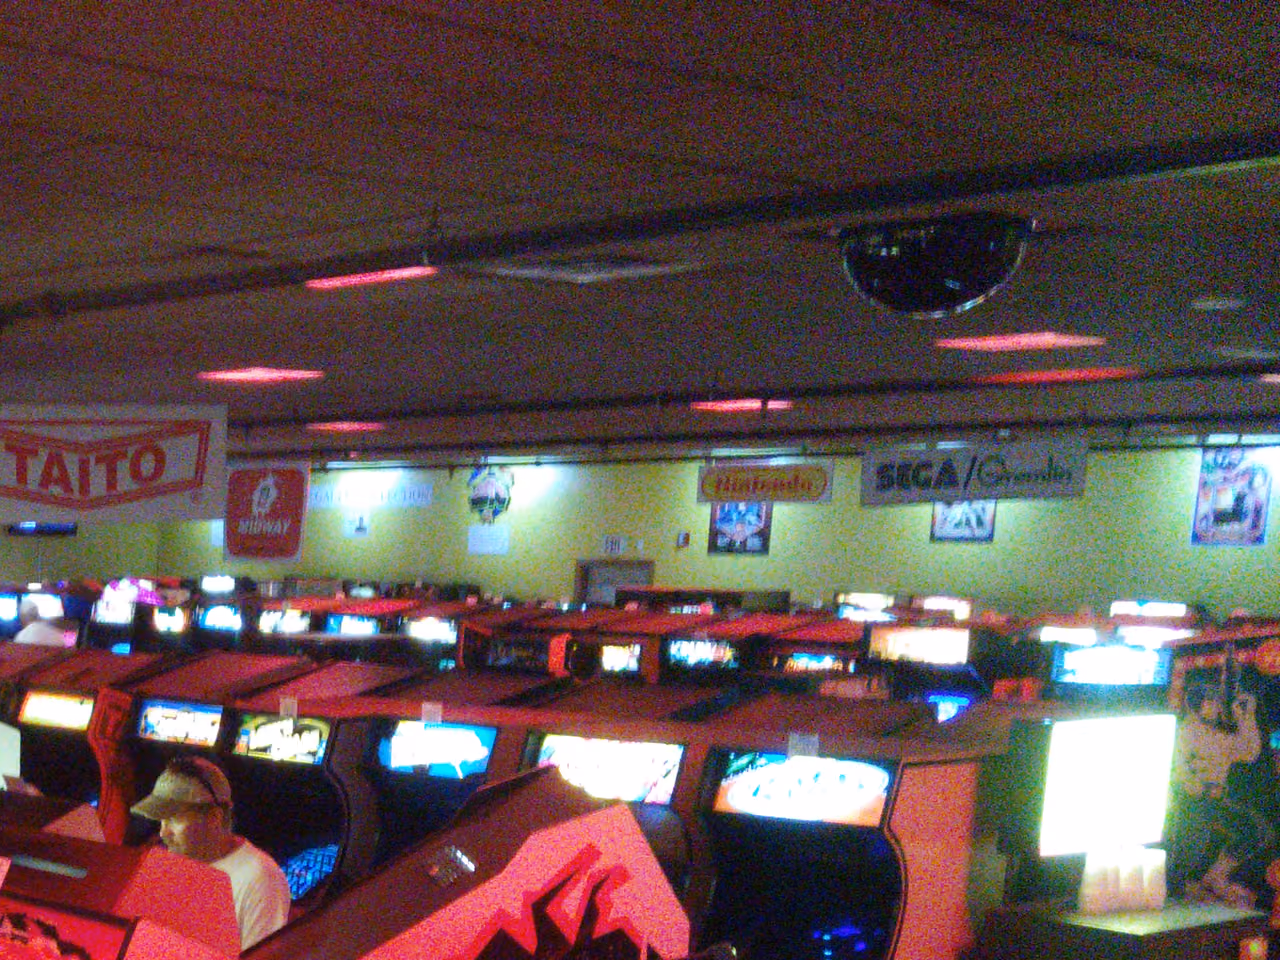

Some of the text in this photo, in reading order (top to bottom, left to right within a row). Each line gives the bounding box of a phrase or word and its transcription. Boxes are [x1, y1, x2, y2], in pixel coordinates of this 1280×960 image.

[5, 438, 166, 497] TAITO
[713, 471, 813, 493] Nintendo
[237, 515, 291, 535] MIDWAY
